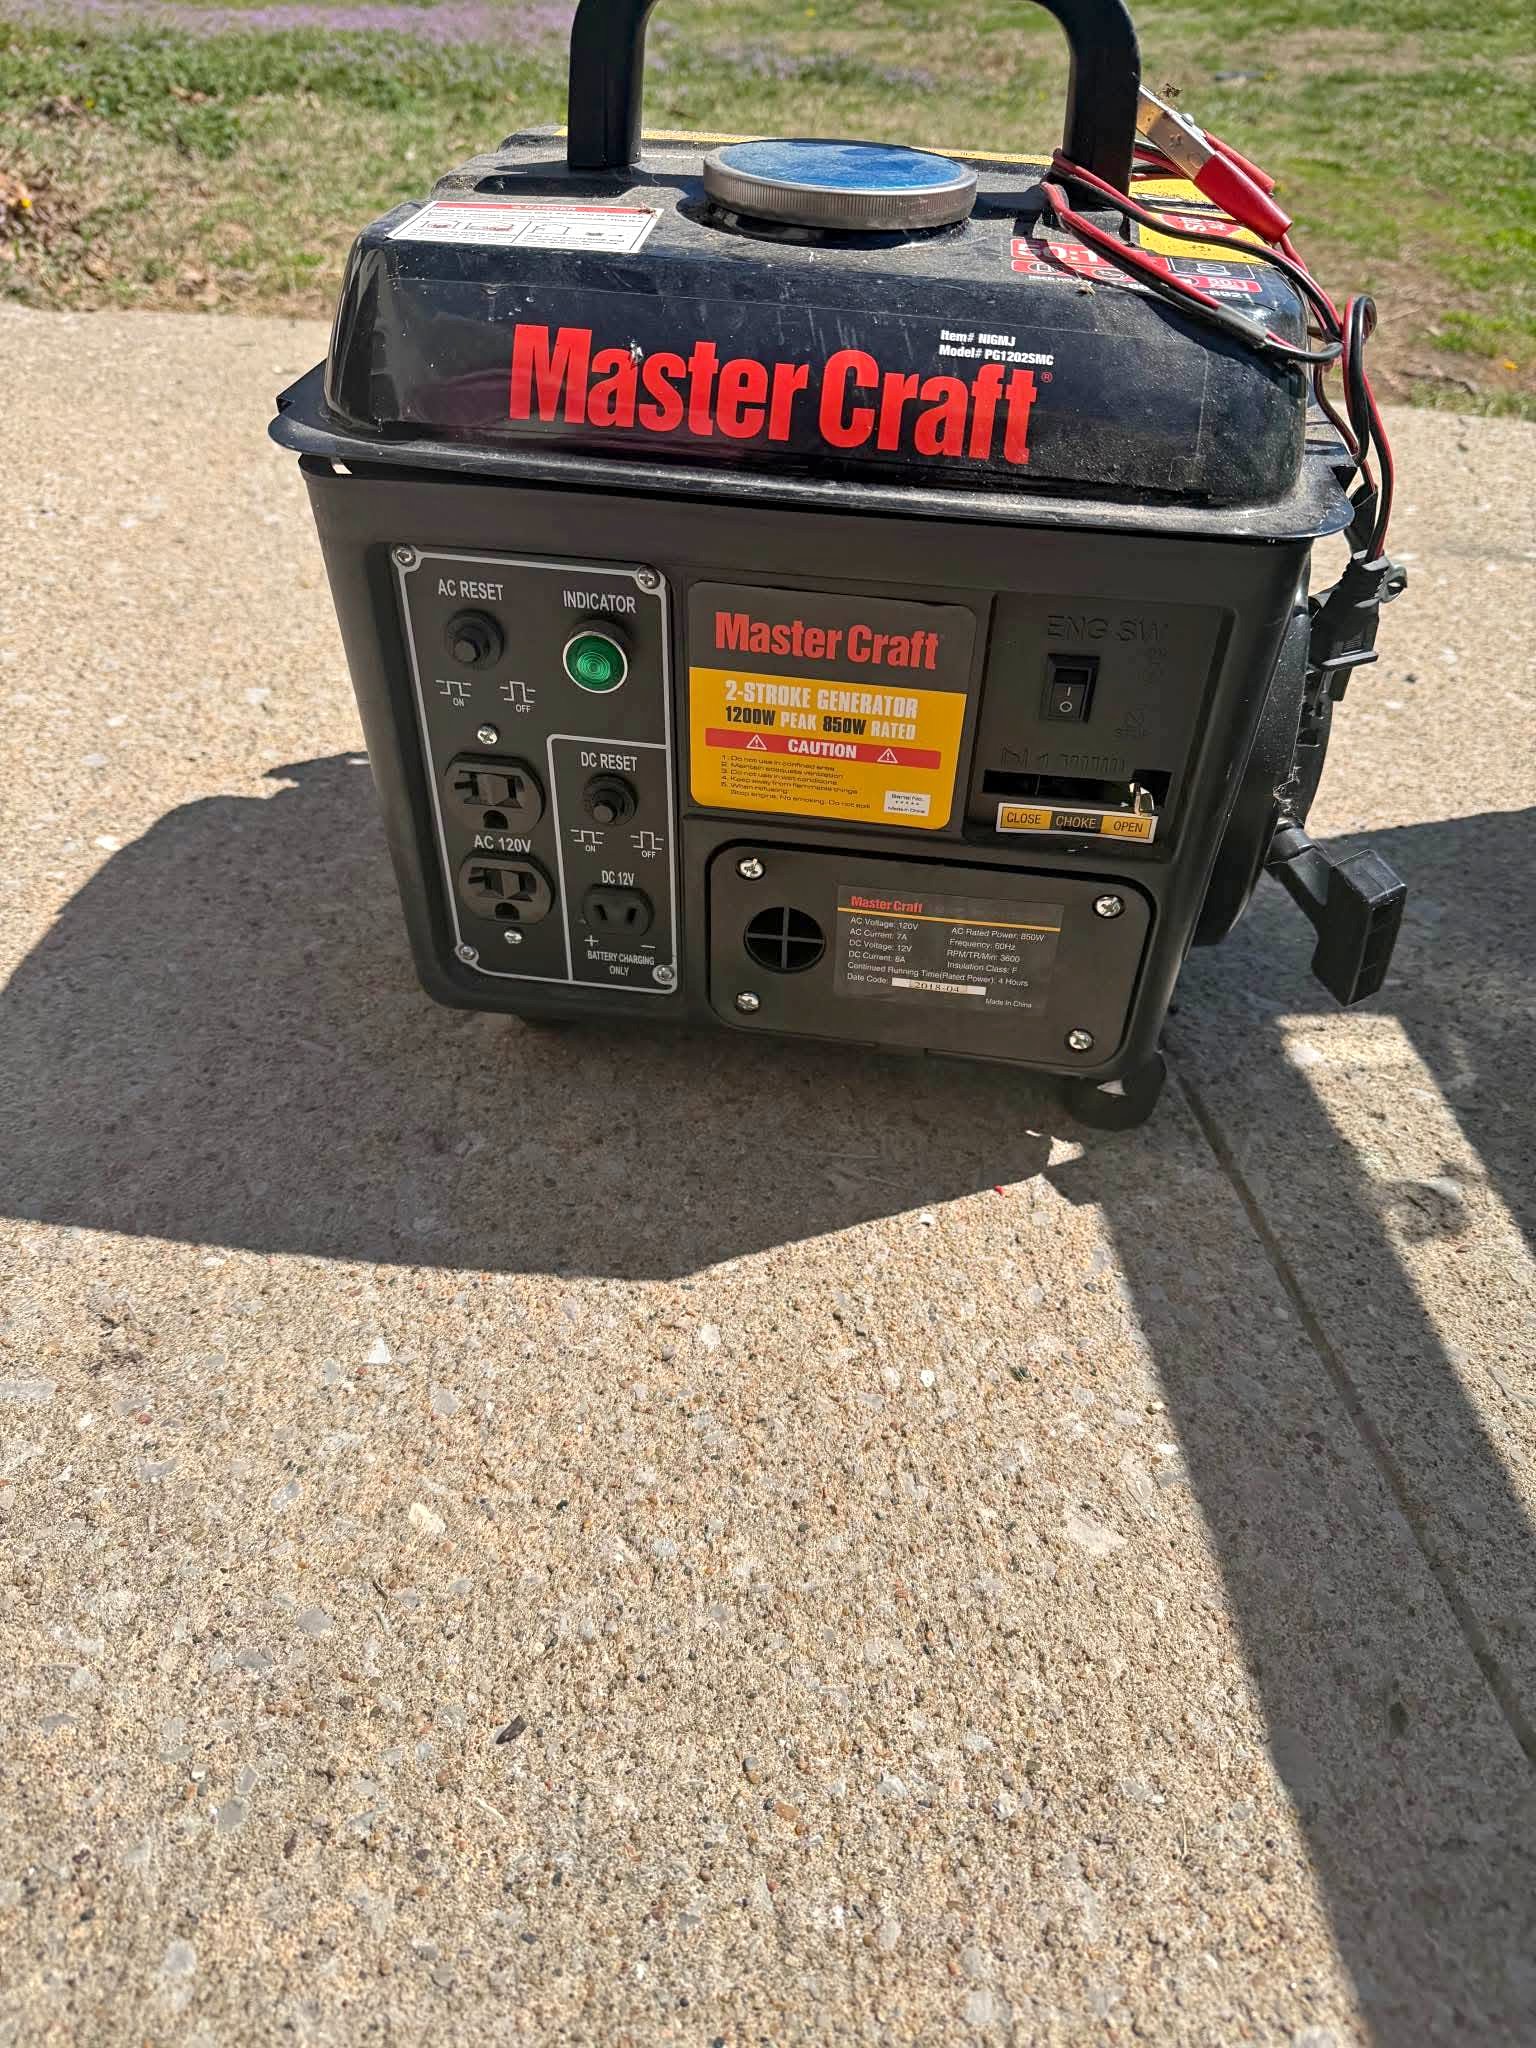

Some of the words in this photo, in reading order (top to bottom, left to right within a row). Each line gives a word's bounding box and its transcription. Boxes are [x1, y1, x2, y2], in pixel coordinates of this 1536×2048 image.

[940, 330, 975, 342] Item#
[939, 344, 983, 358] Model#
[984, 348, 1055, 366] PG1202SMC
[509, 323, 809, 442] Master
[820, 349, 1038, 465] Craft
[438, 578, 456, 597] AC
[460, 582, 504, 601] RESET
[563, 590, 637, 614] INDICATOR
[1047, 615, 1109, 640] ENG
[715, 611, 843, 661] Master
[847, 624, 939, 670] Craft
[452, 698, 465, 707] ON
[724, 680, 811, 708] 2-STROKE
[816, 688, 919, 720] GENERATOR
[515, 704, 531, 713] OFF
[725, 706, 776, 727] 1200W
[780, 712, 818, 731] PEAK
[822, 715, 867, 736] 850W
[871, 720, 916, 740] RATED
[787, 738, 857, 760] CAUTION
[580, 752, 598, 768] DC
[600, 753, 638, 772] RESET
[1006, 813, 1041, 825] CLOSE
[1056, 815, 1097, 829] CHOKE
[1113, 820, 1144, 833] OPEN
[474, 834, 494, 850] AC
[498, 837, 532, 854] 120V
[585, 844, 596, 852] ON
[641, 850, 656, 859] OFF
[602, 870, 616, 884] DC
[618, 872, 635, 886] 12V
[851, 896, 891, 910] Master
[893, 900, 924, 912] Craft
[850, 916, 863, 924] AC
[864, 918, 896, 928] Voltage:
[899, 922, 918, 930] 120V
[864, 929, 894, 939] Current:
[966, 928, 990, 937] Rated
[991, 930, 1018, 939] Power:
[1020, 933, 1046, 942] 850W
[849, 939, 862, 947] DC
[864, 940, 894, 952] Voltage:
[898, 944, 912, 952] 12V
[949, 938, 992, 950] Frequency:
[994, 942, 1016, 950] 60Hz
[587, 950, 618, 962] BATTERY
[618, 952, 656, 966] CHARGING
[862, 952, 892, 961] Current:
[947, 950, 998, 961] RPM/TR/Min:
[1000, 954, 1020, 962] 3600
[609, 965, 630, 976] ONLY
[848, 962, 886, 972] Continued
[888, 966, 919, 977] Running
[1005, 978, 1028, 987] Hours
[947, 961, 984, 971] Insulation
[986, 964, 1009, 974] Class:
[848, 972, 864, 982] Date
[866, 975, 888, 984] Code:
[1013, 1000, 1032, 1008] China
